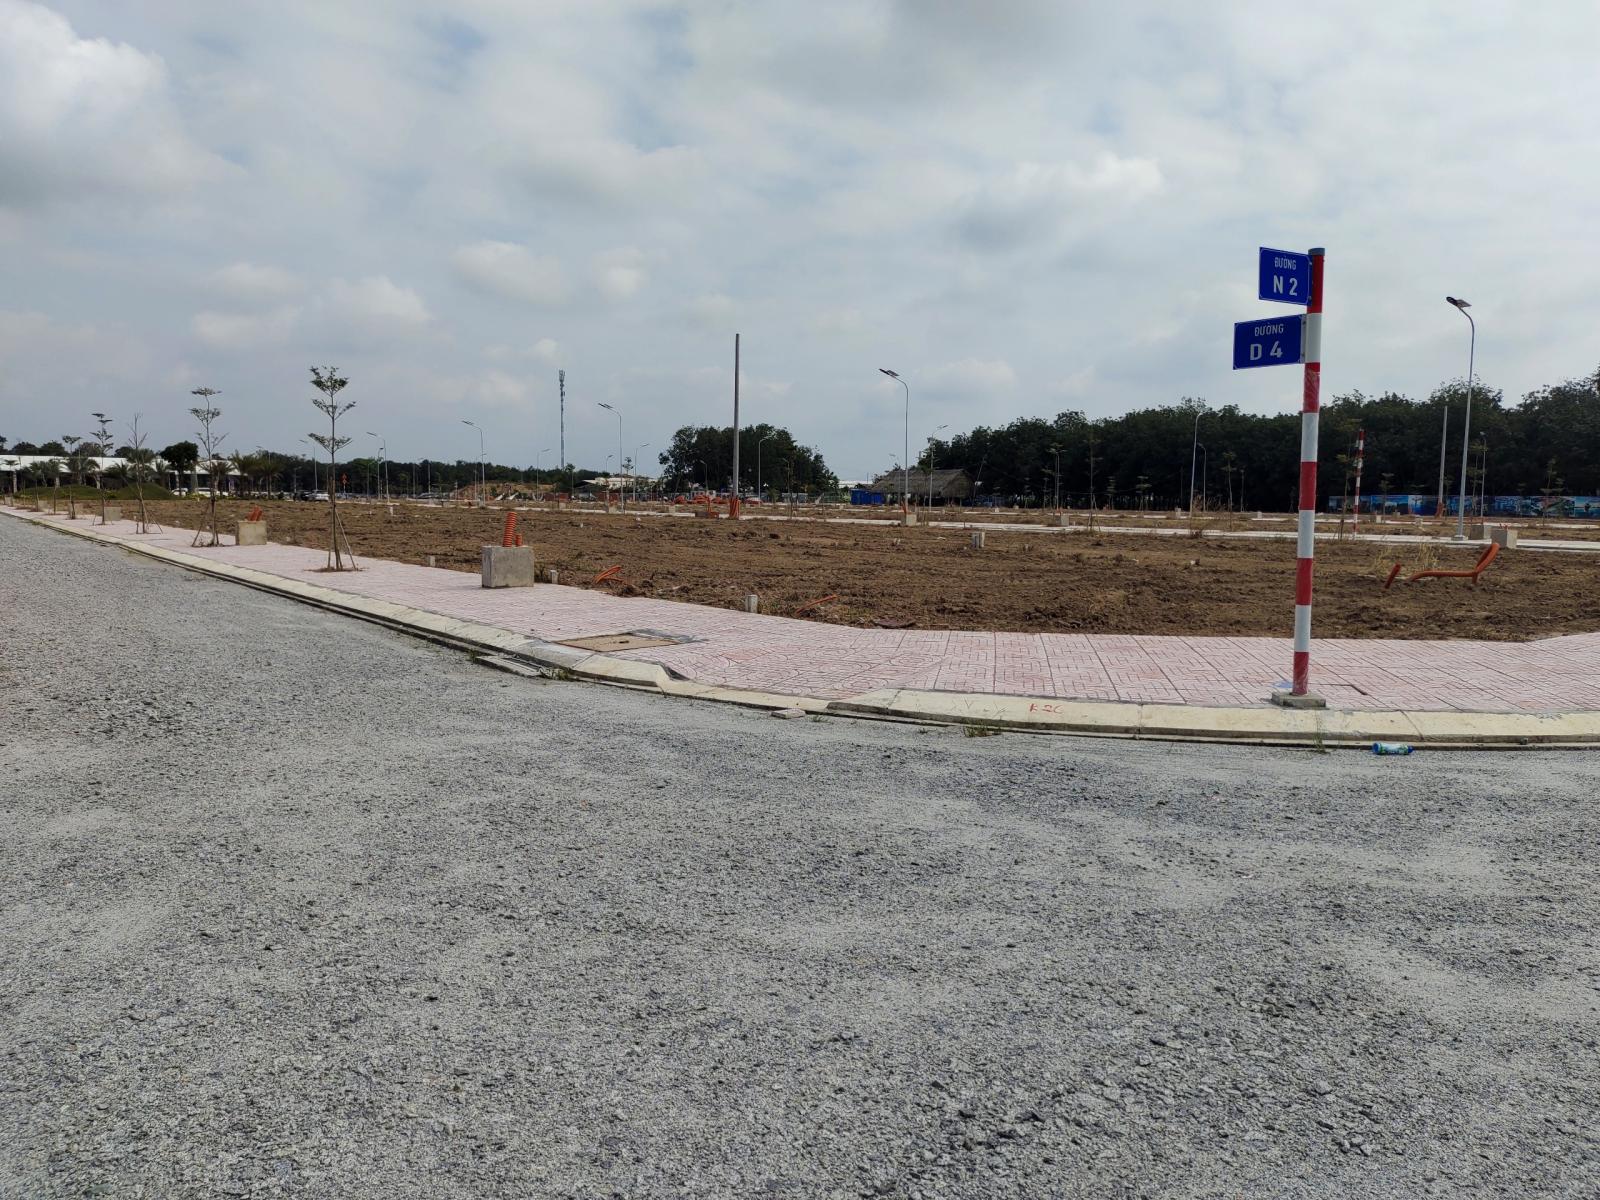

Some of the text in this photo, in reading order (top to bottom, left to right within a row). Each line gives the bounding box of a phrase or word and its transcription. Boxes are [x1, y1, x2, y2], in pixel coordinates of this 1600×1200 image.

[1273, 275, 1298, 297] N 2
[1249, 341, 1283, 361] D 4
